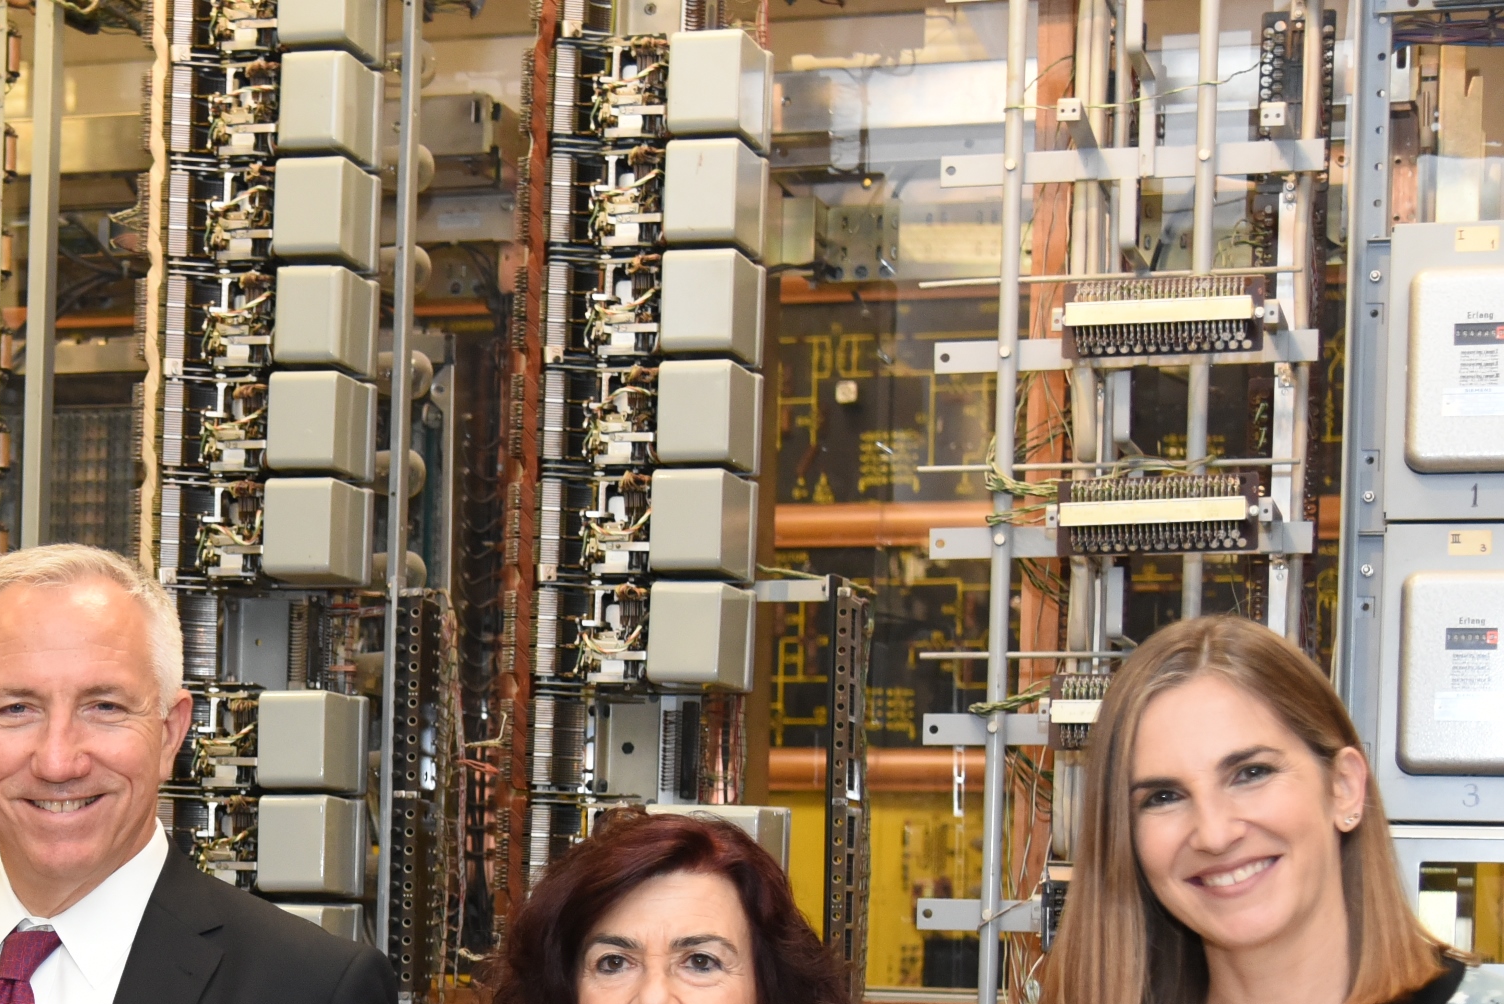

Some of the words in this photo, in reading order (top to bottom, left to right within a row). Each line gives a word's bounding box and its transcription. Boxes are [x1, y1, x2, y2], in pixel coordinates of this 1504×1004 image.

[1467, 311, 1494, 320] Erlang
[1471, 483, 1479, 508] 1
[1450, 533, 1461, 544] III
[1480, 543, 1487, 553] 3
[1459, 617, 1486, 626] Erlang
[1462, 783, 1480, 808] 3
